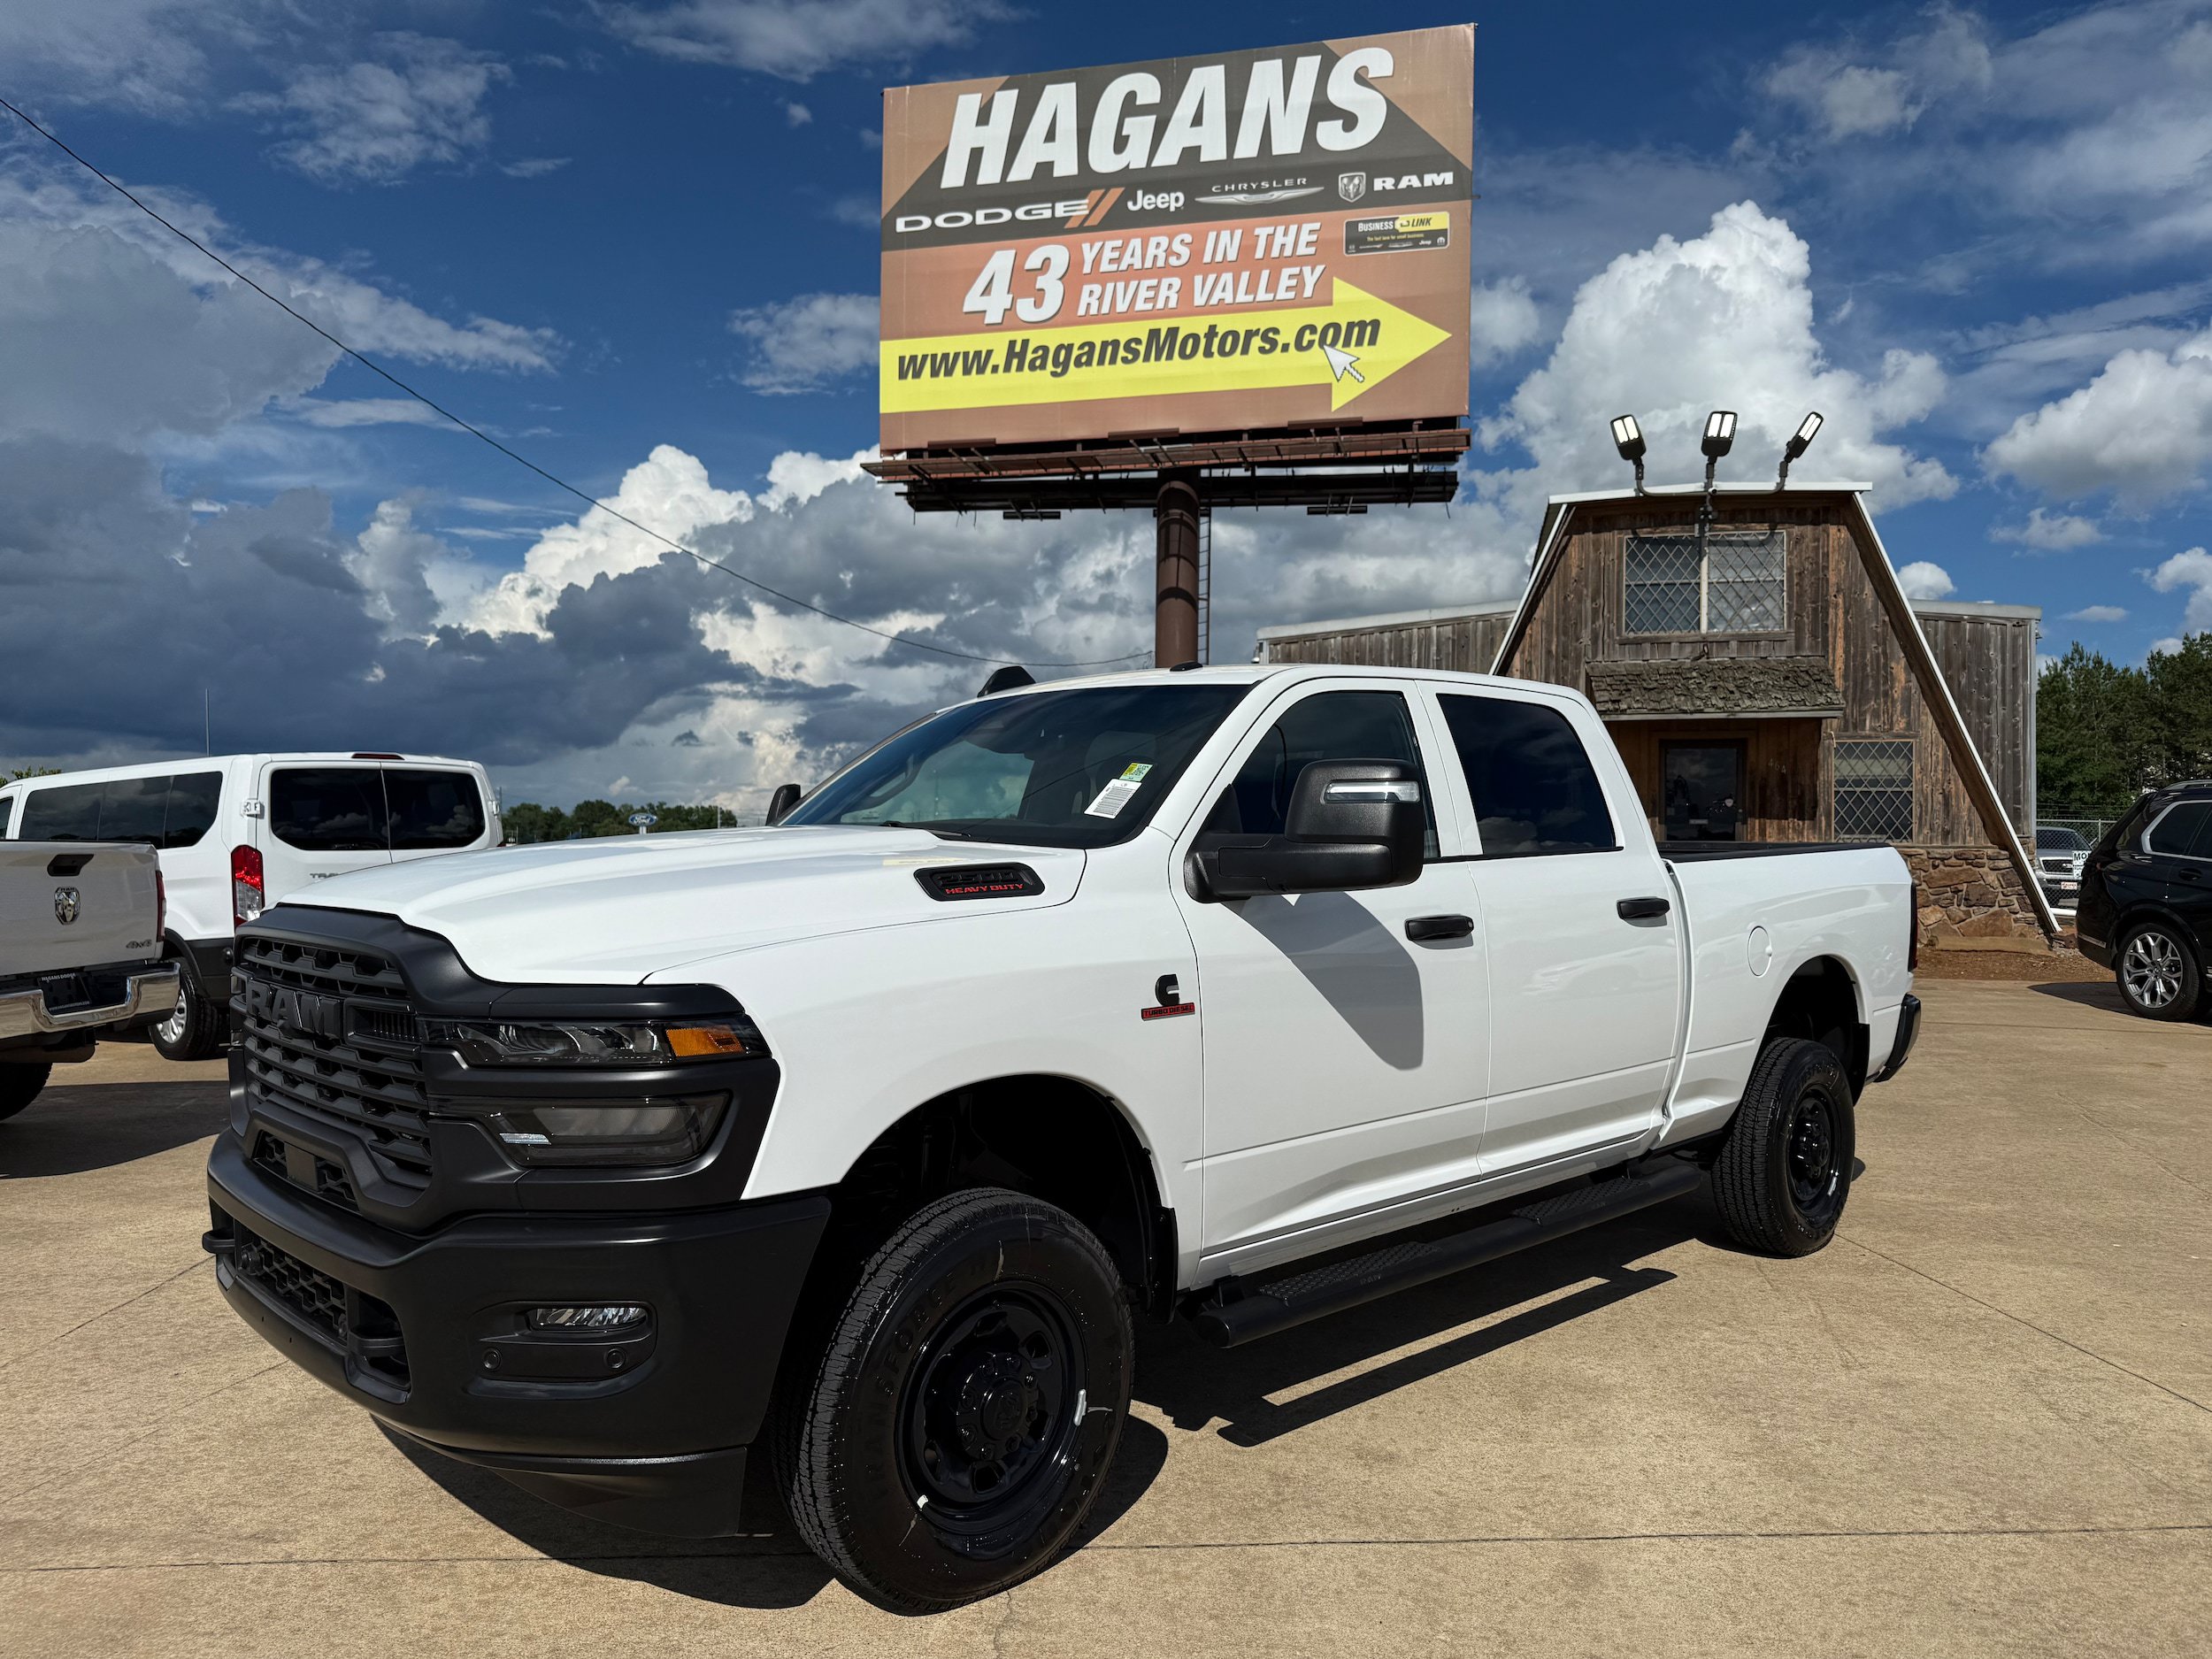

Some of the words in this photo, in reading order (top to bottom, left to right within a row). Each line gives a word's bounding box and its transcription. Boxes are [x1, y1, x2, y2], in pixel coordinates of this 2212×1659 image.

[941, 47, 1394, 189] HAGANS
[1210, 177, 1308, 193] CHRYSLER
[1373, 172, 1455, 191] RAM
[895, 198, 1090, 234] DODGE
[1126, 189, 1186, 212] Jeep
[1357, 220, 1394, 233] BUSINESS
[1411, 217, 1432, 228] LINK
[1080, 234, 1194, 274] YEARS
[1202, 228, 1243, 265] IN
[1253, 221, 1322, 260] THE
[962, 244, 1071, 326] 43
[1077, 276, 1182, 317] RIVER
[1194, 265, 1326, 308] VALLEY
[897, 318, 1381, 381] www.HagansMotors.com
[945, 886, 988, 895] HEAVY
[246, 979, 342, 1038] RAM
[1143, 1008, 1168, 1017] TURBO
[1169, 1004, 1194, 1014] DIESEL
